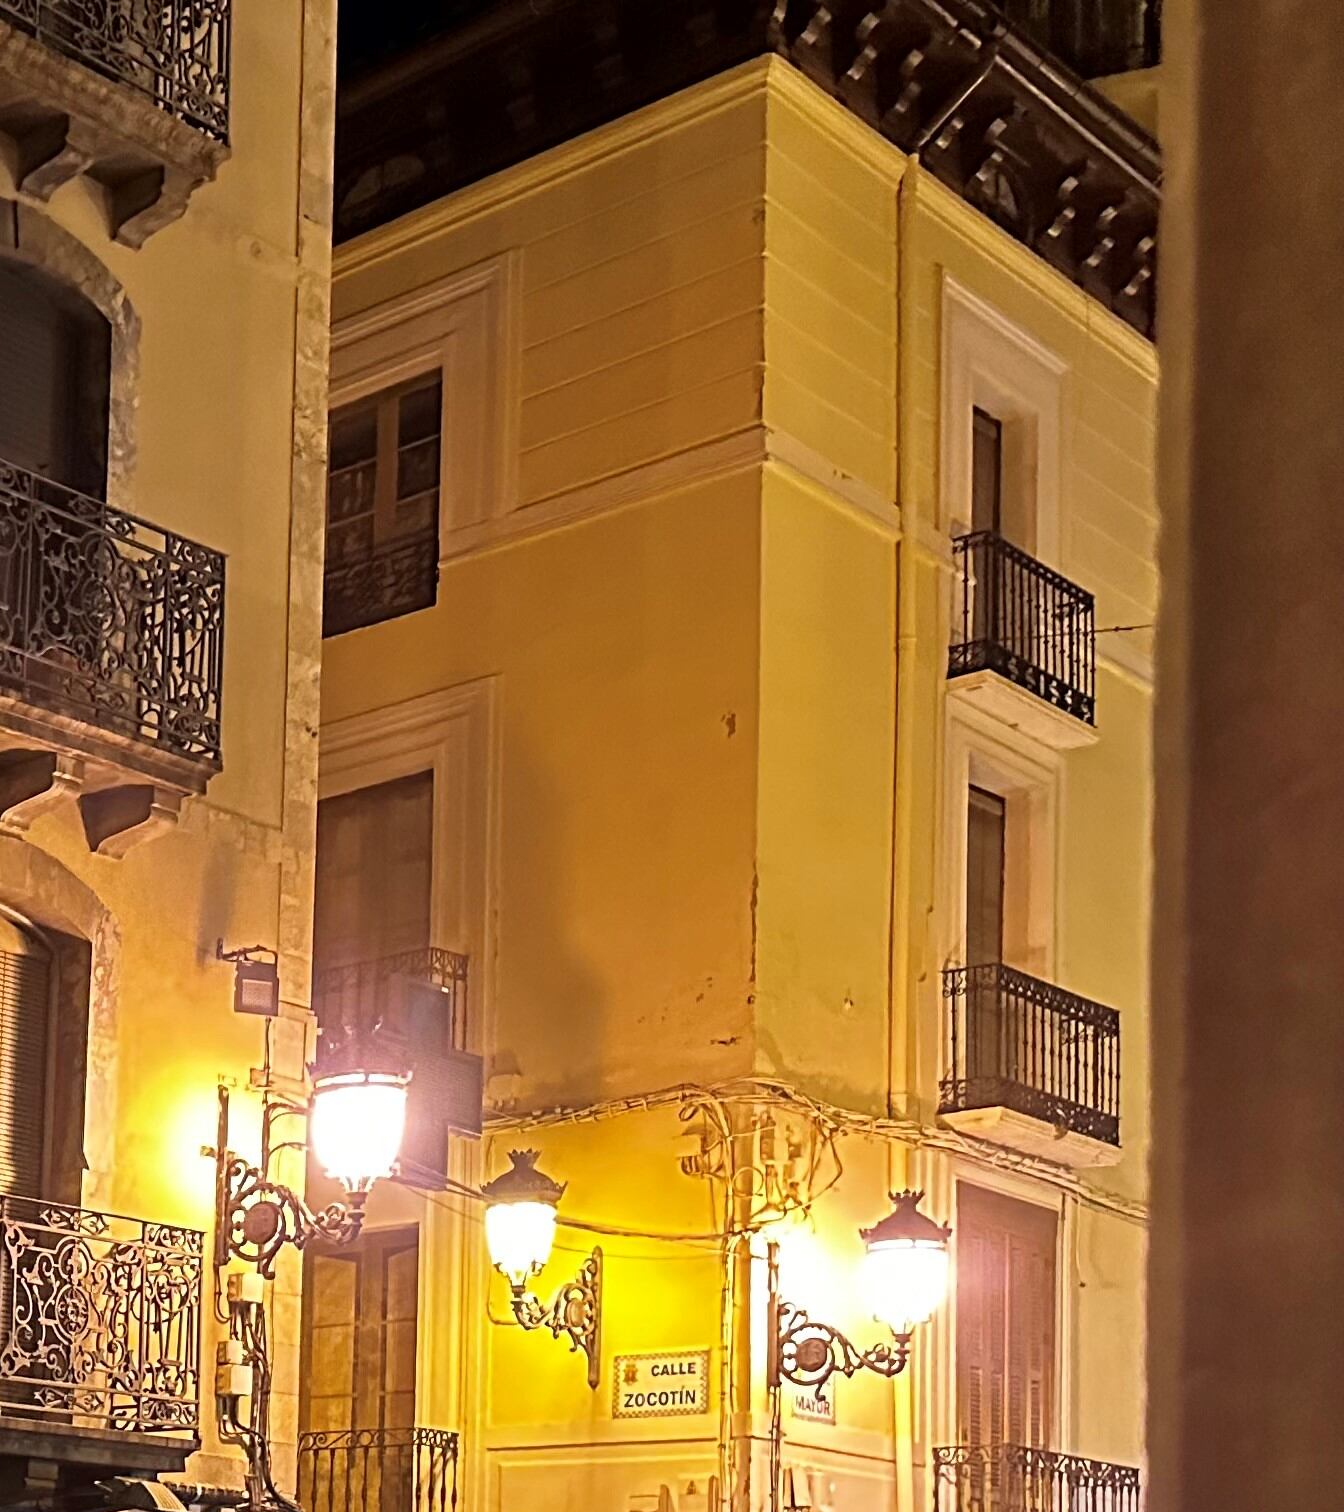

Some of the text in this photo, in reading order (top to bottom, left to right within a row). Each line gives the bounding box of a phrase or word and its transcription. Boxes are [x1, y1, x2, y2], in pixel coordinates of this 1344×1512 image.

[650, 1362, 697, 1377] CALLE
[623, 1387, 697, 1408] ZOCOTÍN
[795, 1394, 831, 1416] MAYOR
